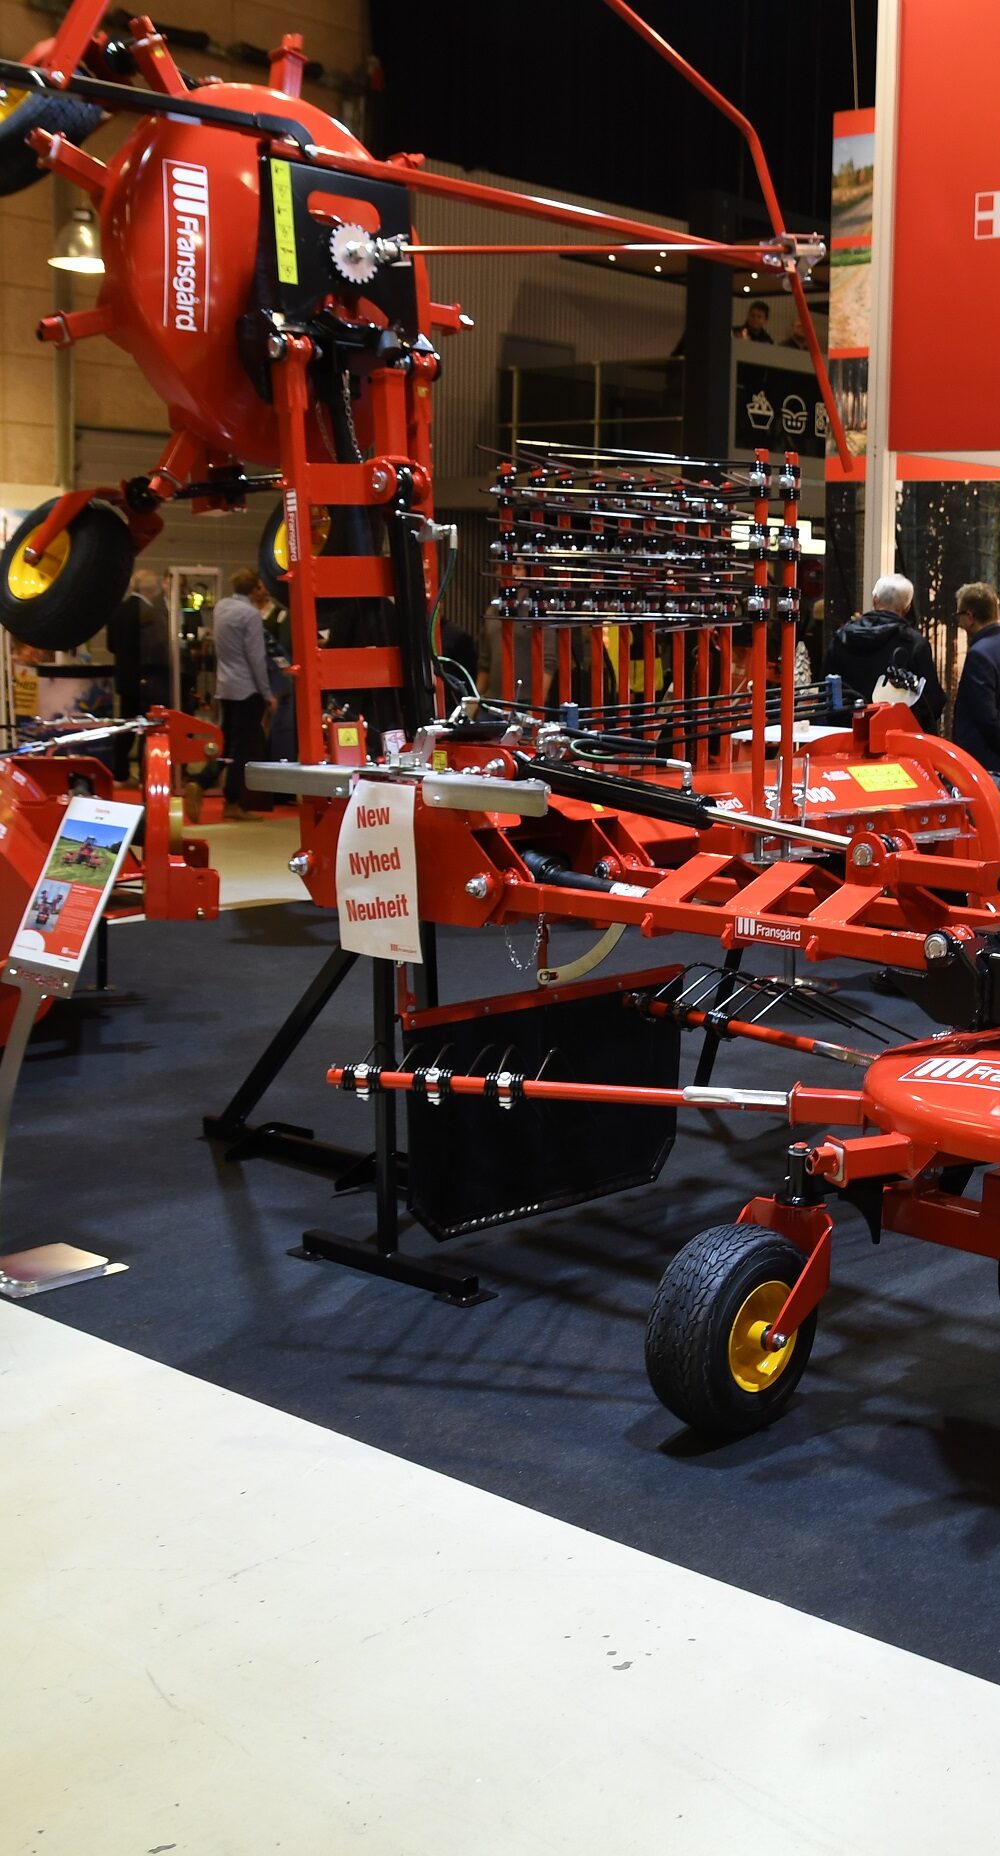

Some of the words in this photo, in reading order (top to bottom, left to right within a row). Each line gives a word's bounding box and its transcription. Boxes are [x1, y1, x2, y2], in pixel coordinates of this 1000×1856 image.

[173, 215, 201, 332] Fransgård
[356, 806, 390, 829] New
[349, 847, 402, 879] Nyhed
[345, 894, 410, 922] Neuheit
[756, 924, 801, 941] Fransgård
